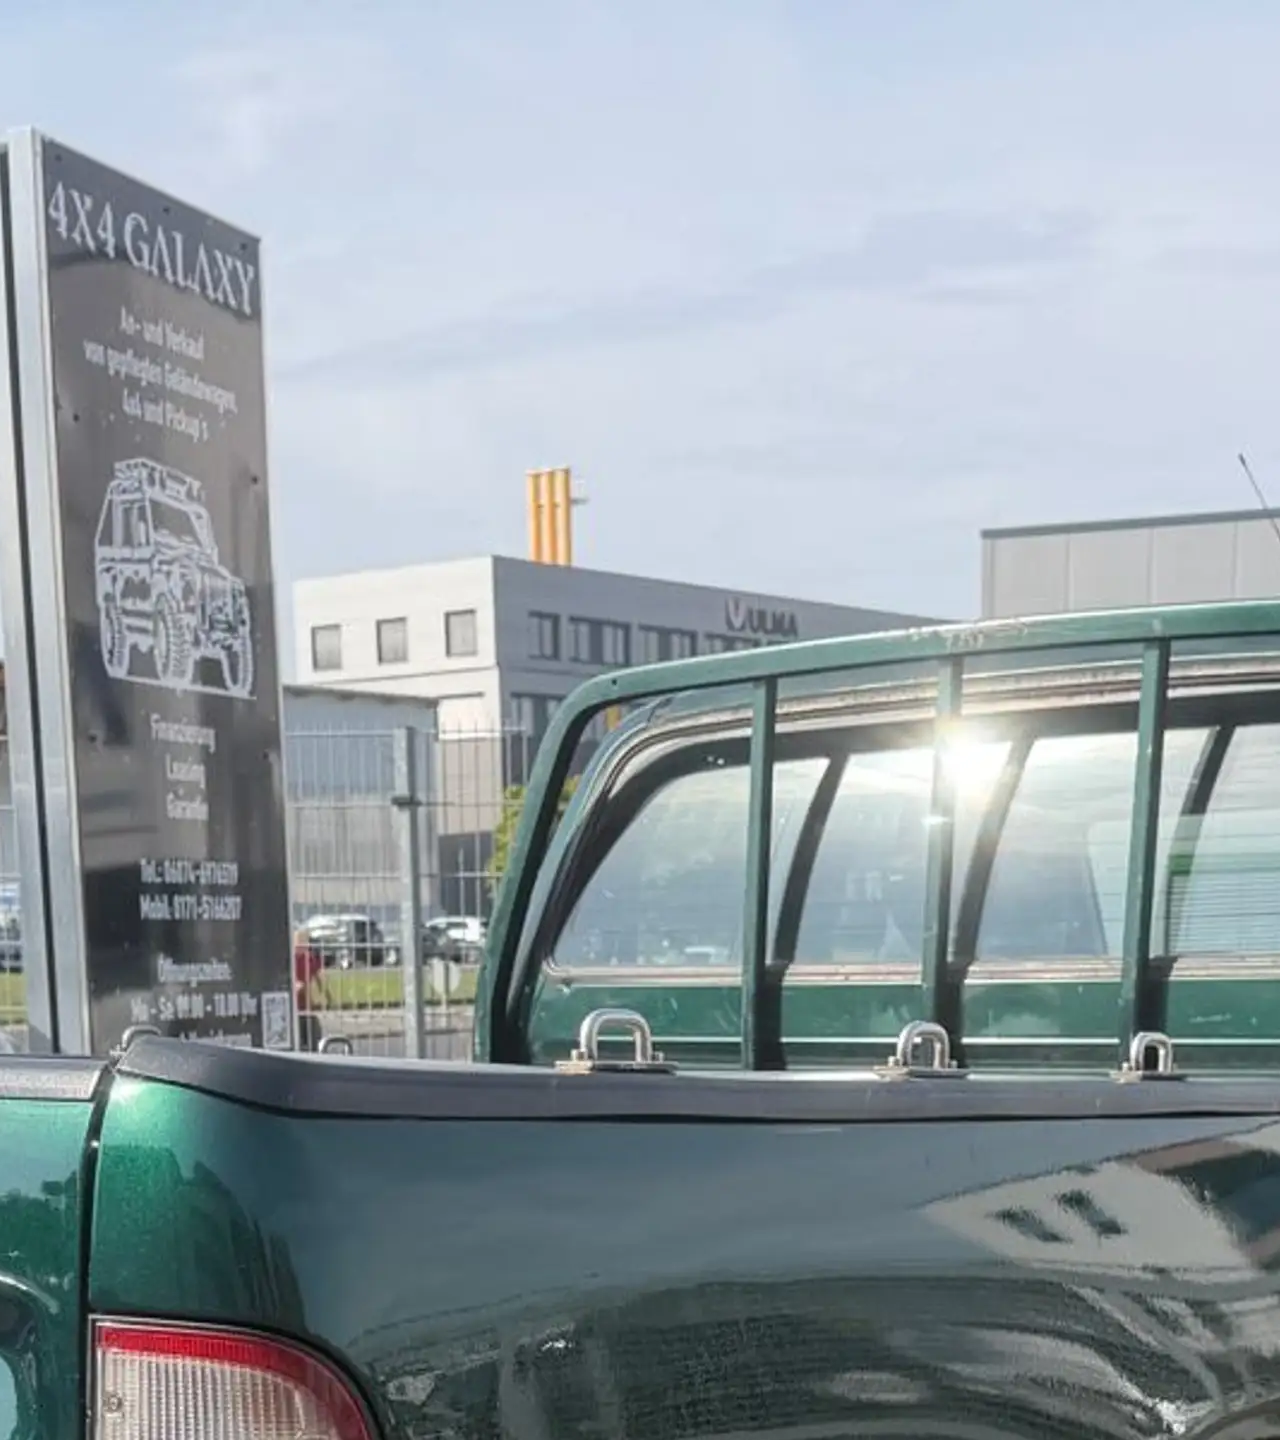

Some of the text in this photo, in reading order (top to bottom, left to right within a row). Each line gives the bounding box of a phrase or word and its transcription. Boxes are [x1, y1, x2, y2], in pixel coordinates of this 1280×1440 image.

[48, 181, 255, 316] 4X4 GALAXY
[166, 754, 206, 789] Leasing
